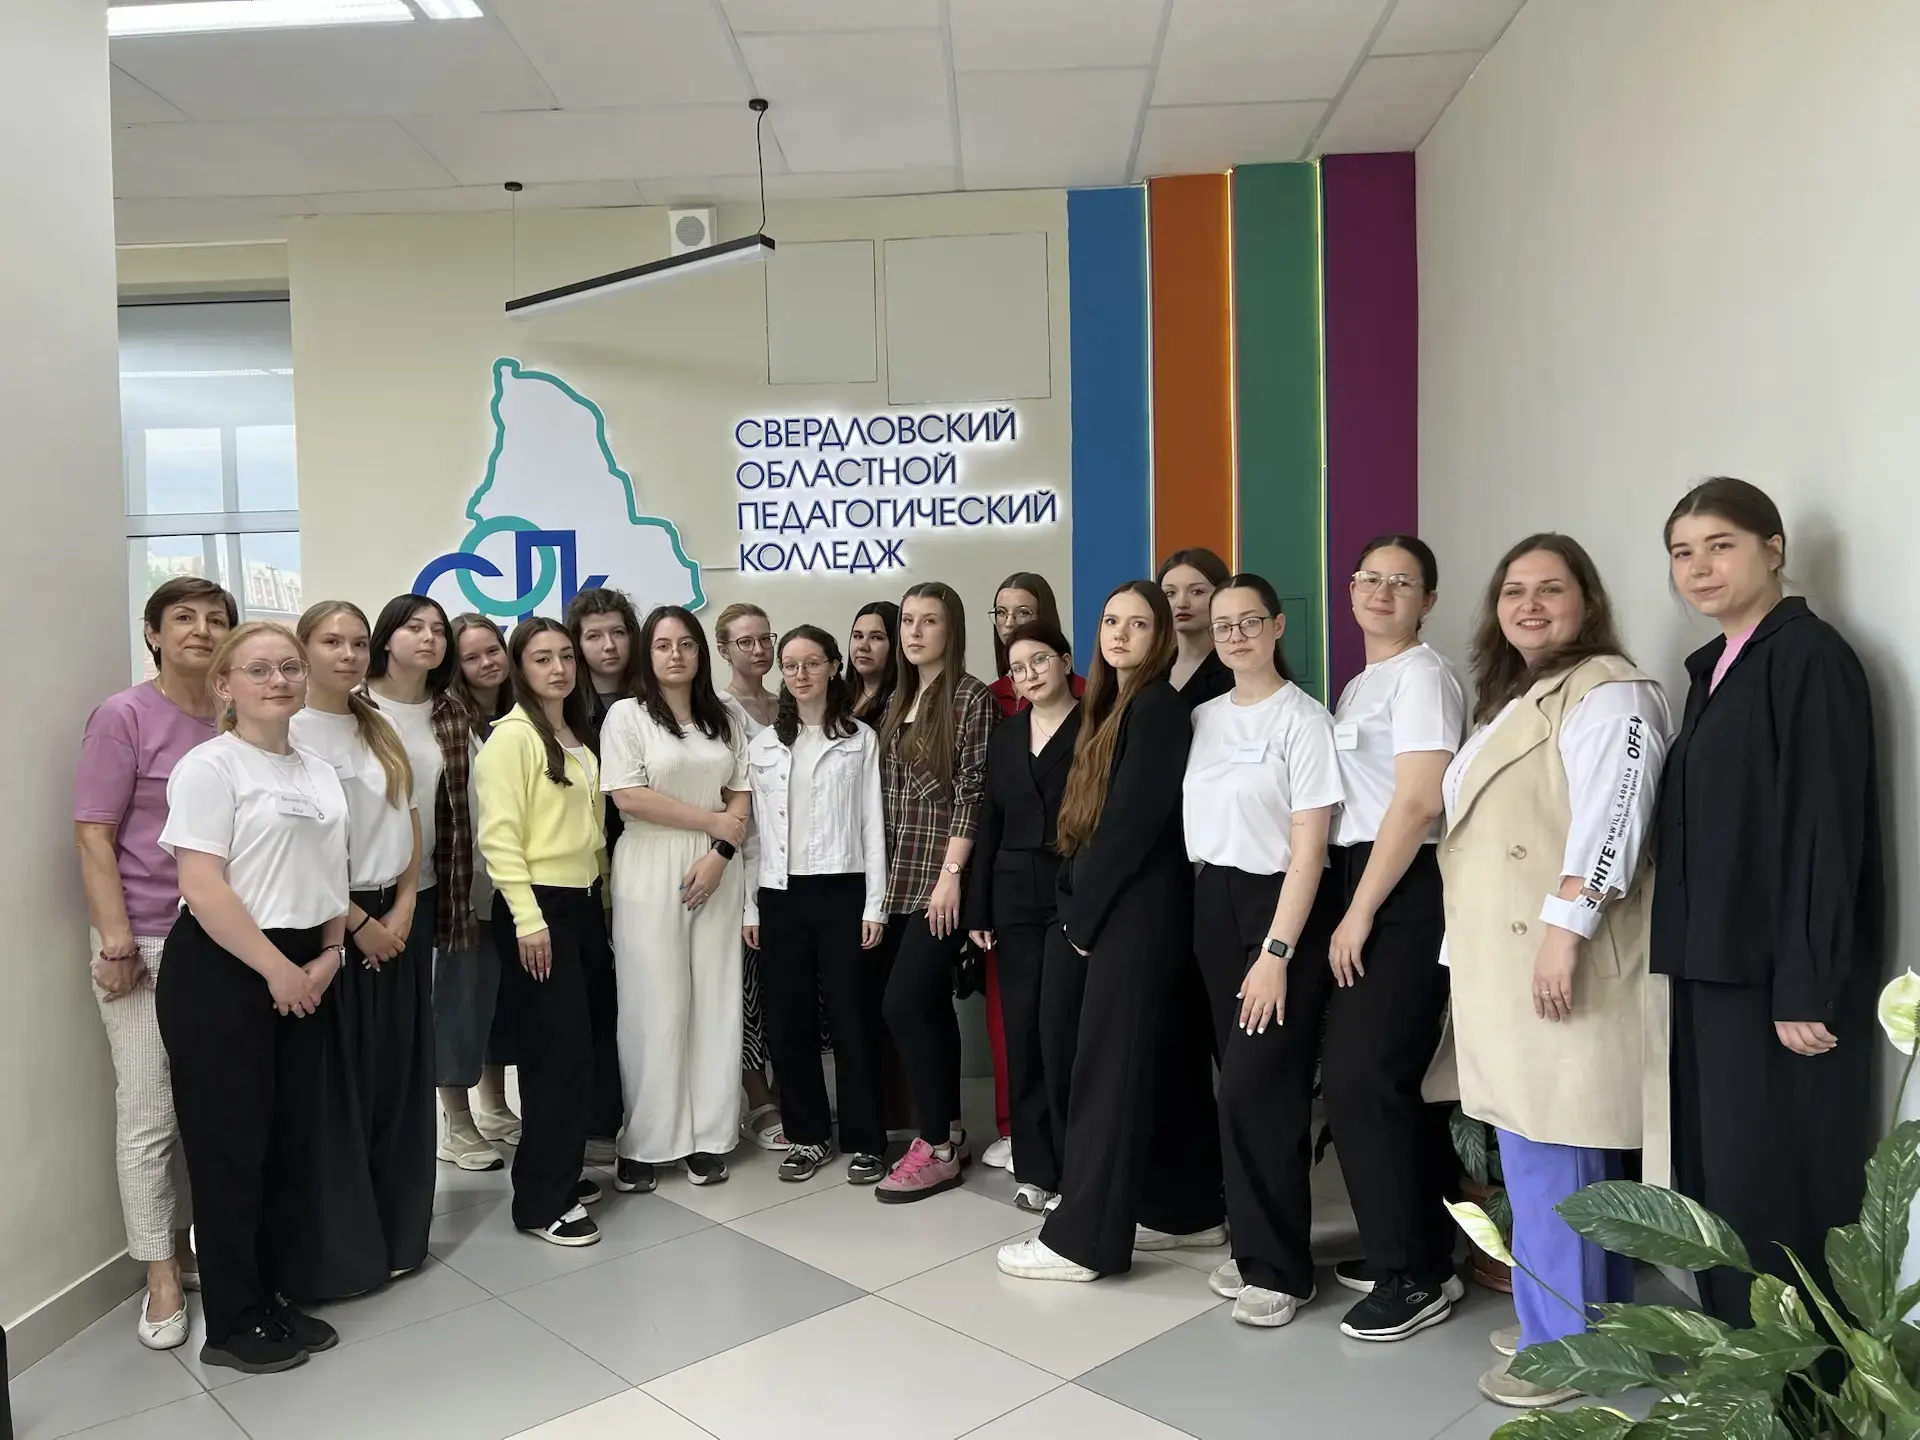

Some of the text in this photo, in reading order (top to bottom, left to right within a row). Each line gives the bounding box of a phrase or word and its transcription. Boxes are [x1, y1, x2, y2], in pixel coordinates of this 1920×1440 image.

[735, 408, 1017, 451] СВЕРДЛОВСКИЙ
[736, 453, 957, 490] ОБЛАСТНОЙ
[738, 490, 1057, 534] ПЕДАГОГИЧЕСКИЙ
[740, 539, 906, 573] КОЛЛЕДЖ
